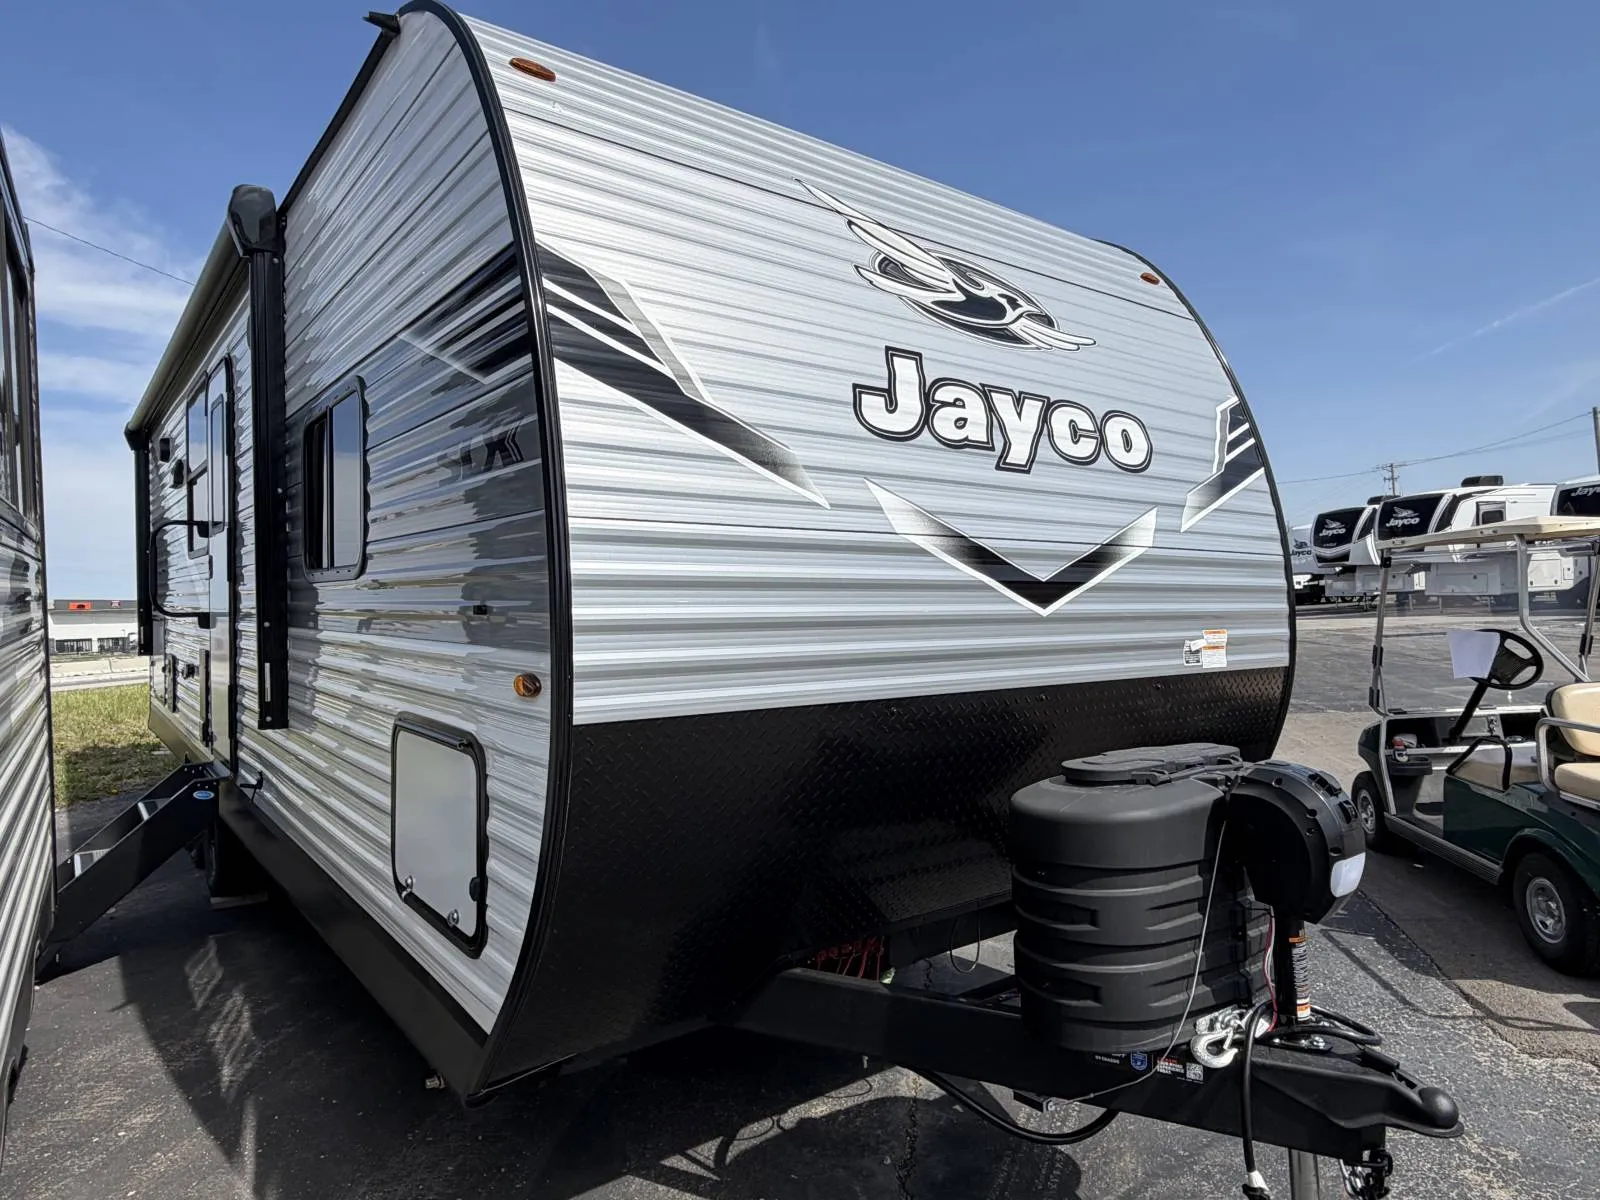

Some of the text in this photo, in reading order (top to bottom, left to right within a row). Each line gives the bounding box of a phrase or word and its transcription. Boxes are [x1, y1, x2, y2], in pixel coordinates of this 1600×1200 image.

[852, 345, 1153, 474] Jayco
[1385, 517, 1421, 528] Jayco
[1319, 528, 1347, 537] Jayco
